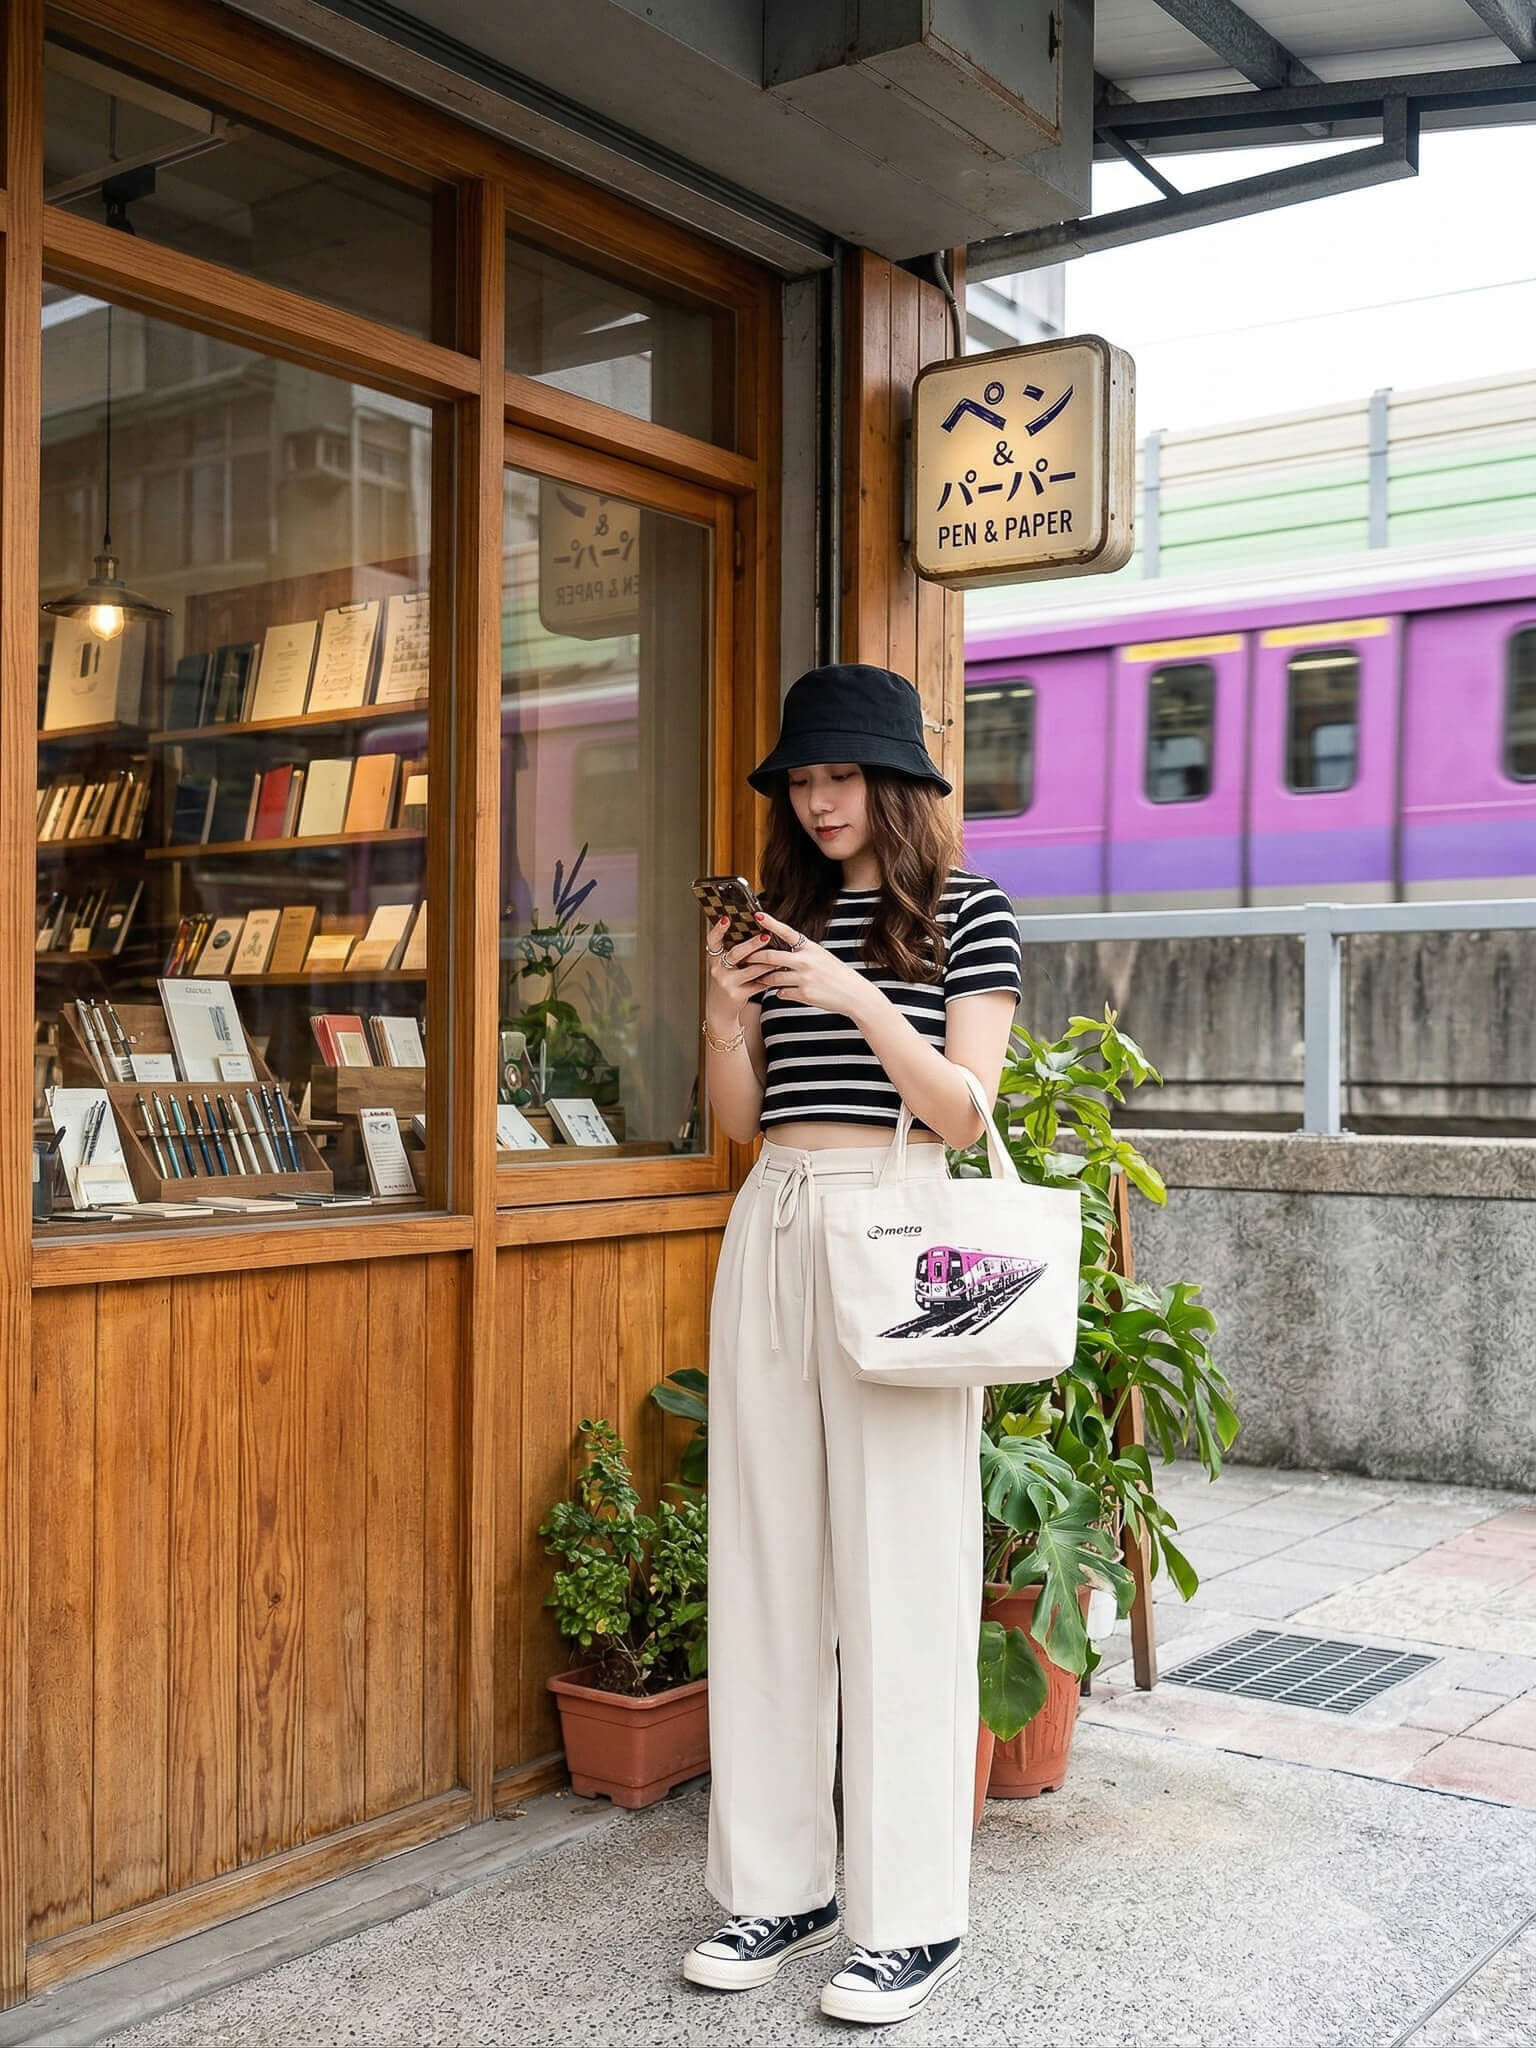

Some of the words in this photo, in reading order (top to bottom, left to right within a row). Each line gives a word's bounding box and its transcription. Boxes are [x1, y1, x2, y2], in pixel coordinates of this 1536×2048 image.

[940, 381, 1074, 437] ペン
[992, 440, 1015, 466] &
[936, 457, 1077, 512] パーパー
[938, 522, 977, 549] PEN
[984, 519, 998, 544] &
[1005, 509, 1073, 541] PAPER
[885, 1225, 922, 1236] metro
